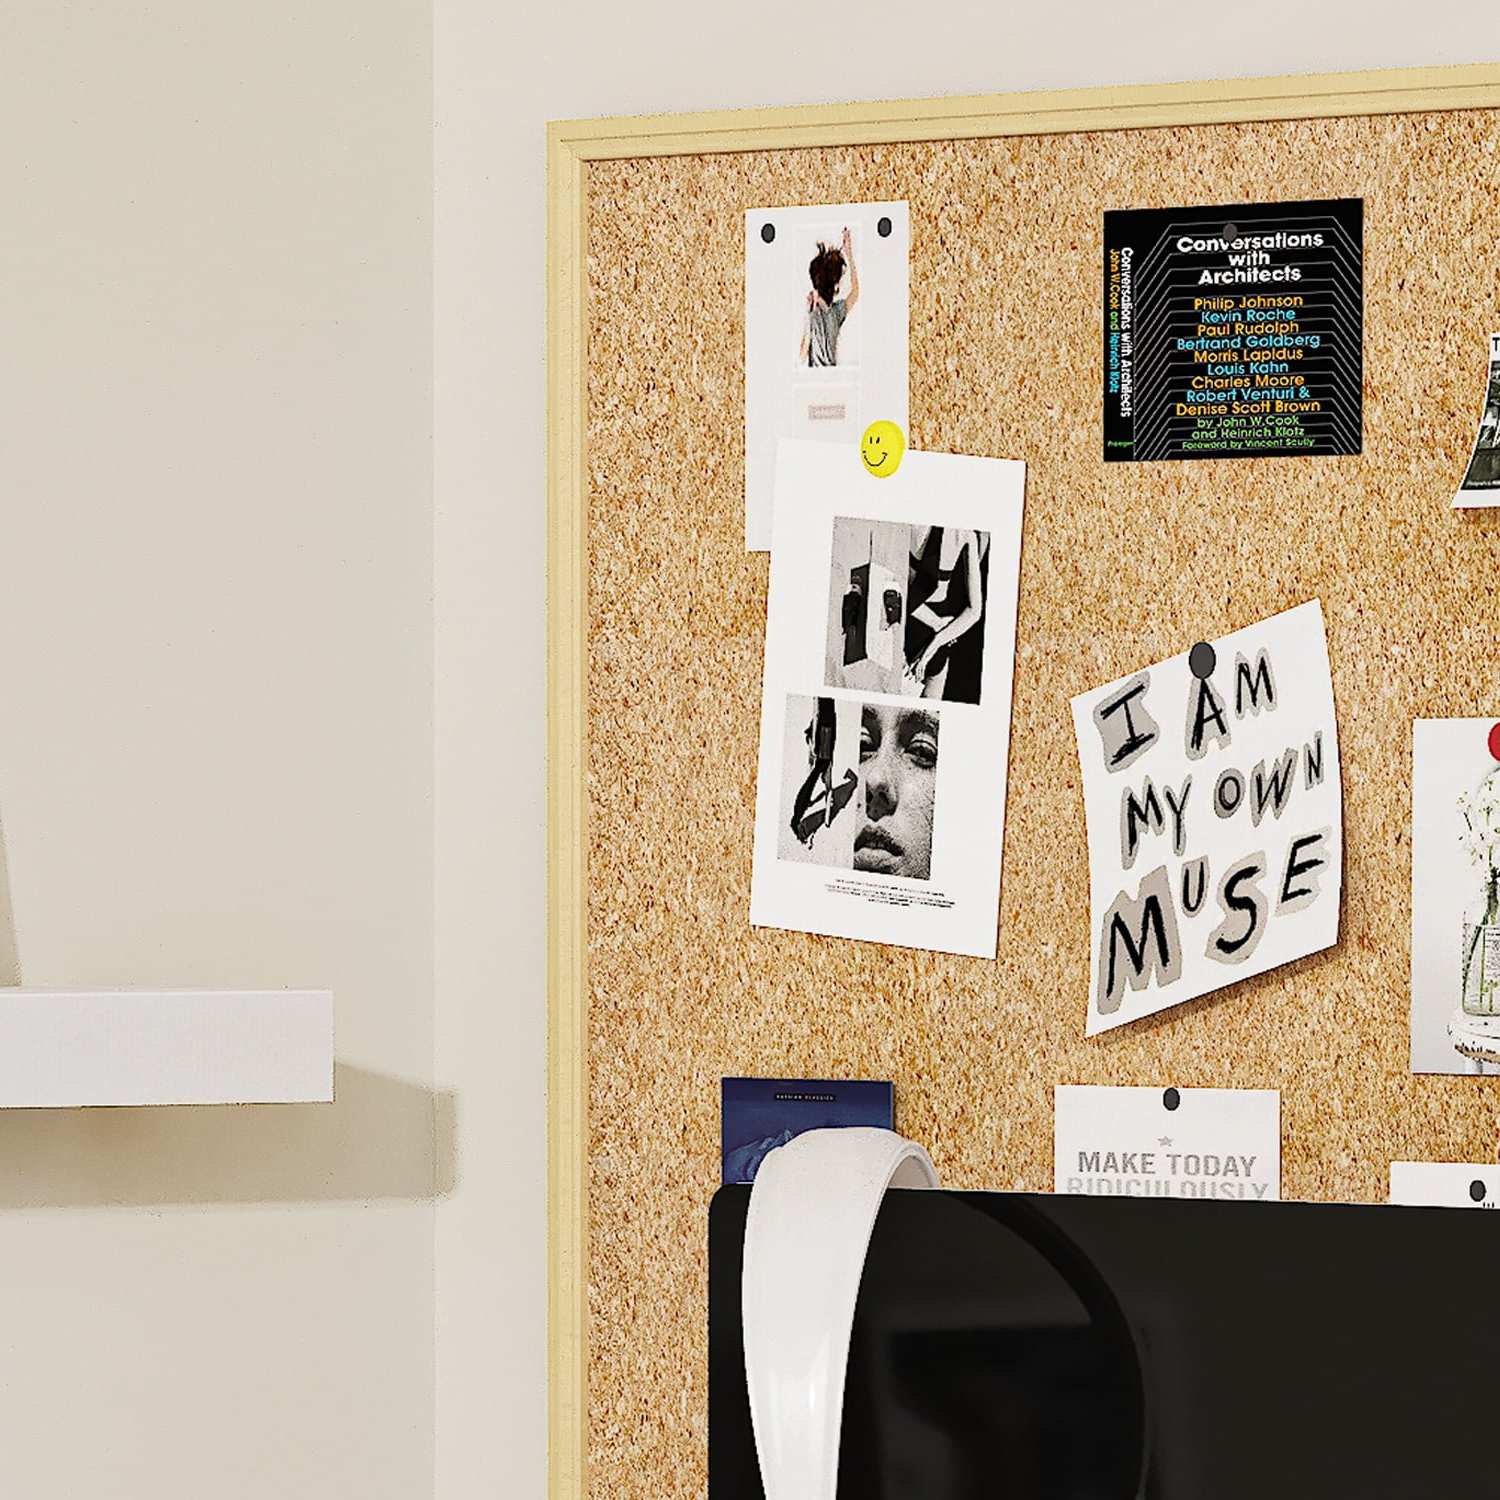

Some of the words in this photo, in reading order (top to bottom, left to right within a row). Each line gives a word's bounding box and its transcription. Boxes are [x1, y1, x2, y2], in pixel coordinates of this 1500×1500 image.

[1176, 232, 1324, 253] Conversations
[1228, 250, 1270, 266] with
[1198, 265, 1301, 285] Architects
[1121, 247, 1134, 330] Conversations
[1194, 297, 1235, 312] Philip
[1239, 295, 1303, 308] Johnson
[1201, 311, 1242, 323] Kevin
[1246, 309, 1296, 320] Roche
[1197, 323, 1230, 336] Paul
[1235, 321, 1299, 335] Rudolph
[1121, 332, 1133, 357] with
[1177, 336, 1241, 350] Bertrand
[1245, 335, 1320, 348] Goldberg
[1194, 349, 1239, 363] Morris
[1243, 348, 1303, 362] Lapidus
[1207, 363, 1245, 375] Louis
[1249, 361, 1289, 374] Kahn
[1191, 376, 1251, 389] Charles
[1255, 375, 1305, 387] Moore
[1186, 388, 1237, 402] Robert
[1241, 387, 1295, 400] Venturi
[1299, 386, 1310, 398] &
[1176, 402, 1228, 416] Denise
[1231, 401, 1271, 414] Scott
[1275, 400, 1321, 412] Brown
[1197, 417, 1213, 429] by
[1216, 417, 1247, 427] John
[1191, 429, 1217, 439] and
[1221, 427, 1271, 438] Heinrich
[1275, 427, 1305, 437] Klotz
[1100, 682, 1156, 766] I
[1190, 655, 1275, 752] AM
[1127, 781, 1192, 858] MY
[1218, 736, 1323, 816] OWN
[1106, 833, 1326, 1000] MUSE
[1077, 1151, 1156, 1174] MAKE
[1166, 1154, 1257, 1177] TODAY
